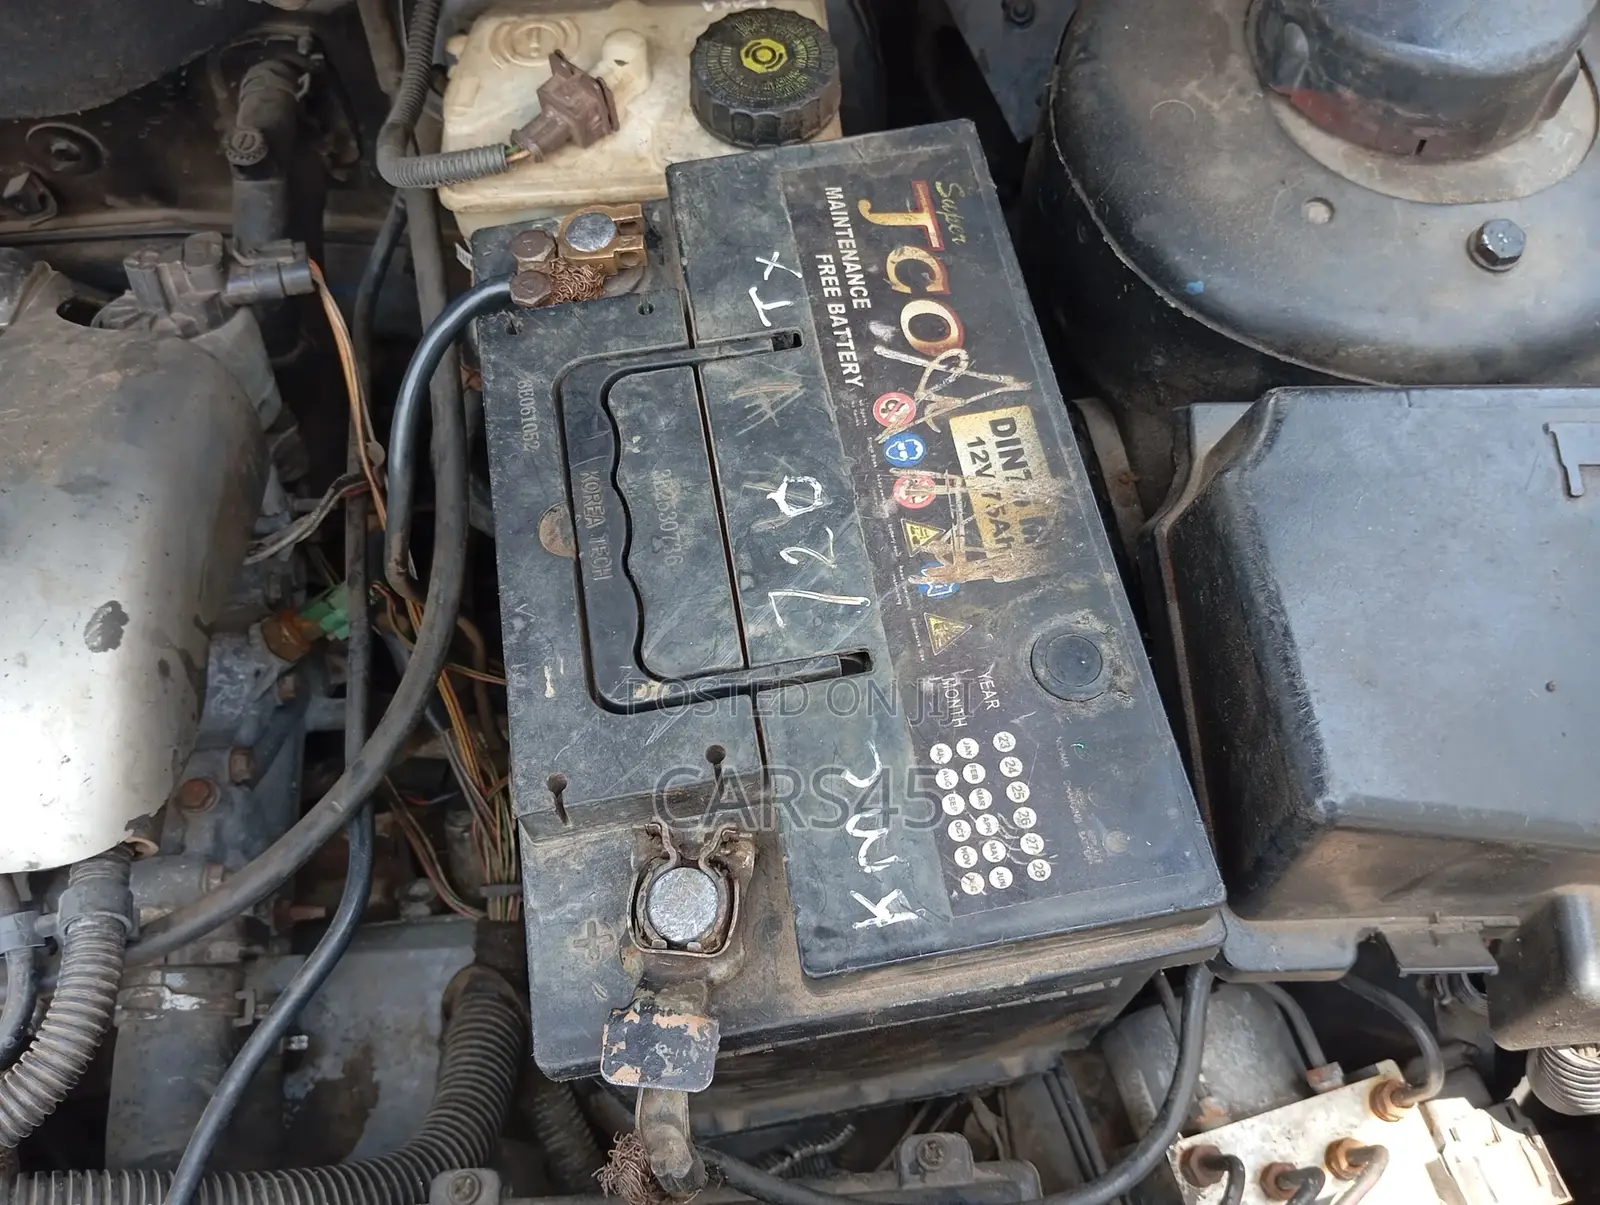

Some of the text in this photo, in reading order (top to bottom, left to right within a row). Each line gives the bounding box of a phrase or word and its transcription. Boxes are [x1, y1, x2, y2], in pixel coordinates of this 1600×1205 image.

[825, 187, 872, 310] MAINTENANCE
[935, 181, 966, 245] Super
[815, 254, 843, 299] FREE
[827, 302, 864, 388] BATTERY
[966, 436, 995, 479] 12V
[580, 470, 614, 581] KOREA TECH
[941, 677, 968, 728] MONTH
[977, 664, 1001, 711] YEAR
[942, 770, 953, 787] AUG
[948, 796, 958, 812] SEP
[954, 821, 966, 838] OCT
[960, 847, 971, 866] NOV
[962, 740, 1007, 888] JAN FEB MAR APR MAY JUN
[997, 735, 1047, 879] 23 24 25 26 27 28
